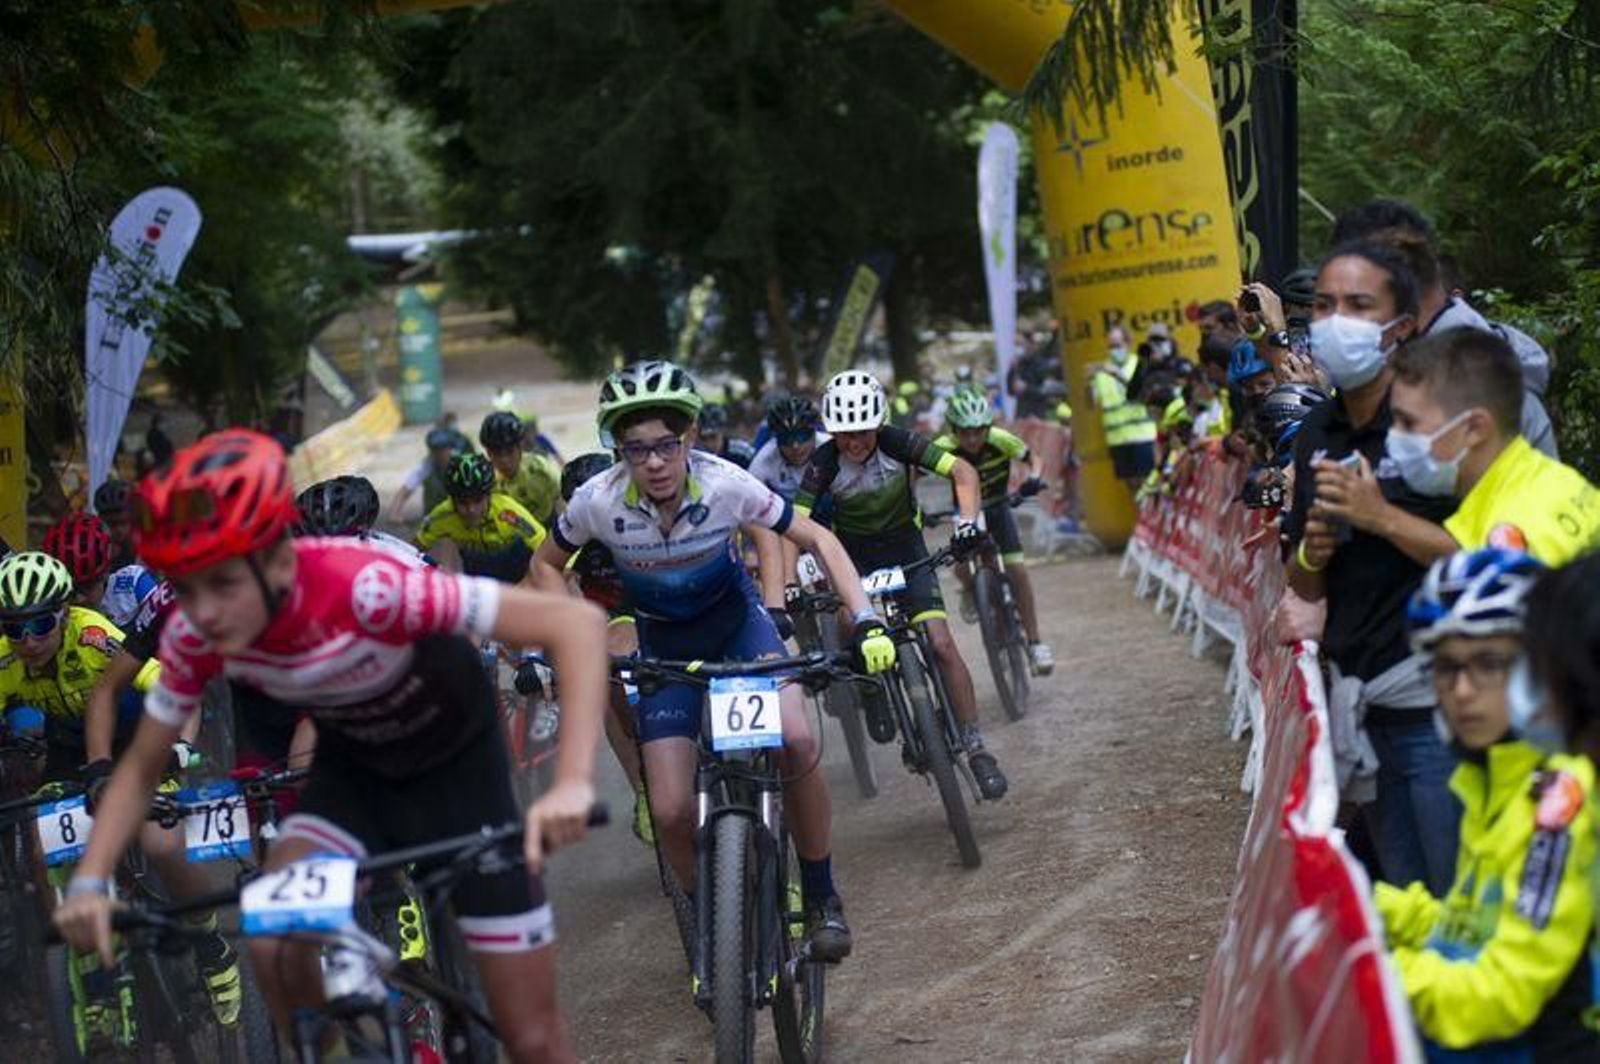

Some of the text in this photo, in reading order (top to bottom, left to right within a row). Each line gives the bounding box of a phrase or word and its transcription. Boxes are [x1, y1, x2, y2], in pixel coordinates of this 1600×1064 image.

[1106, 145, 1184, 172] inorde
[727, 694, 766, 732] 62
[59, 812, 77, 844] 8
[201, 803, 236, 843] 73
[270, 866, 329, 902] 25
